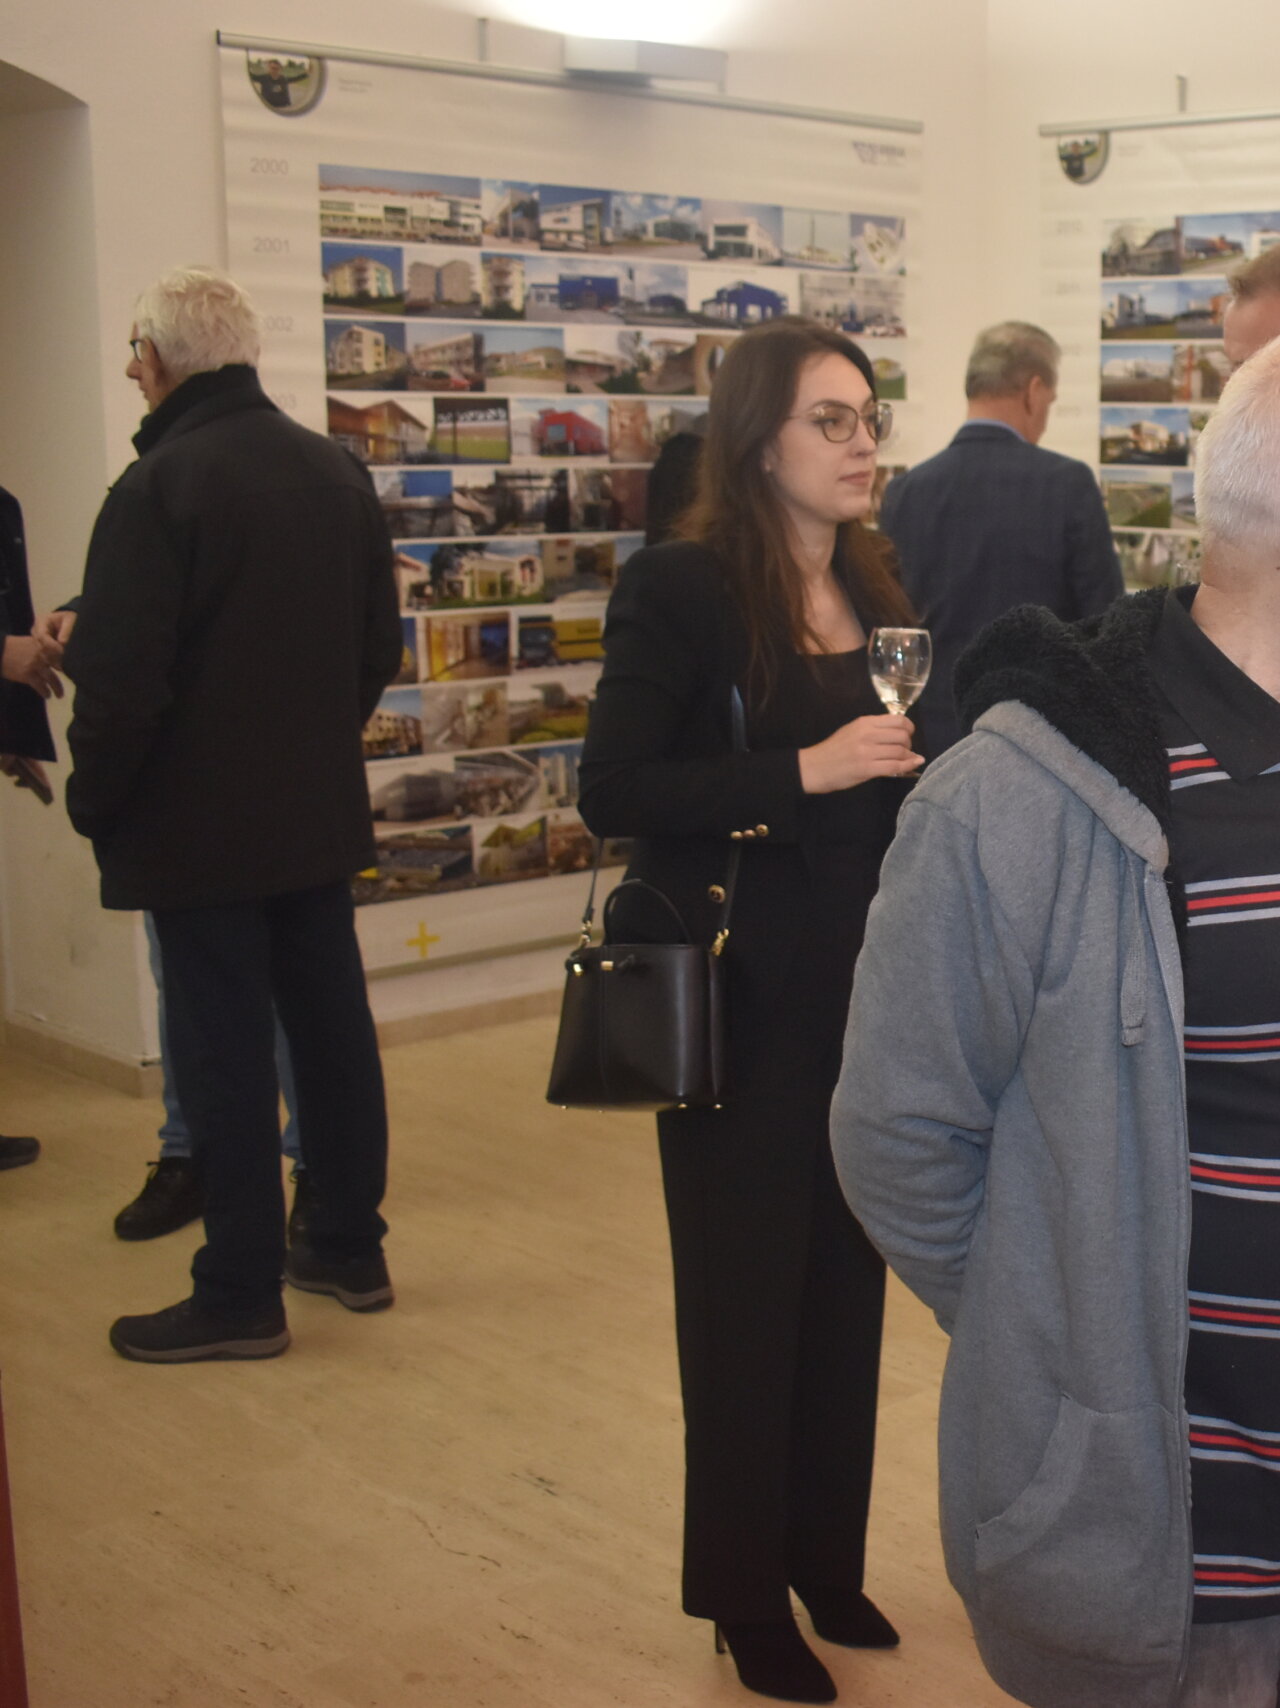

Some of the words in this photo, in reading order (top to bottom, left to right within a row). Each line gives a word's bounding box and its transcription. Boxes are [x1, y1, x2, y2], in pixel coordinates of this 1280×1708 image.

[249, 156, 289, 176] 2000
[252, 235, 290, 254] 2001
[264, 315, 294, 332] 002
[270, 393, 297, 410] 03
